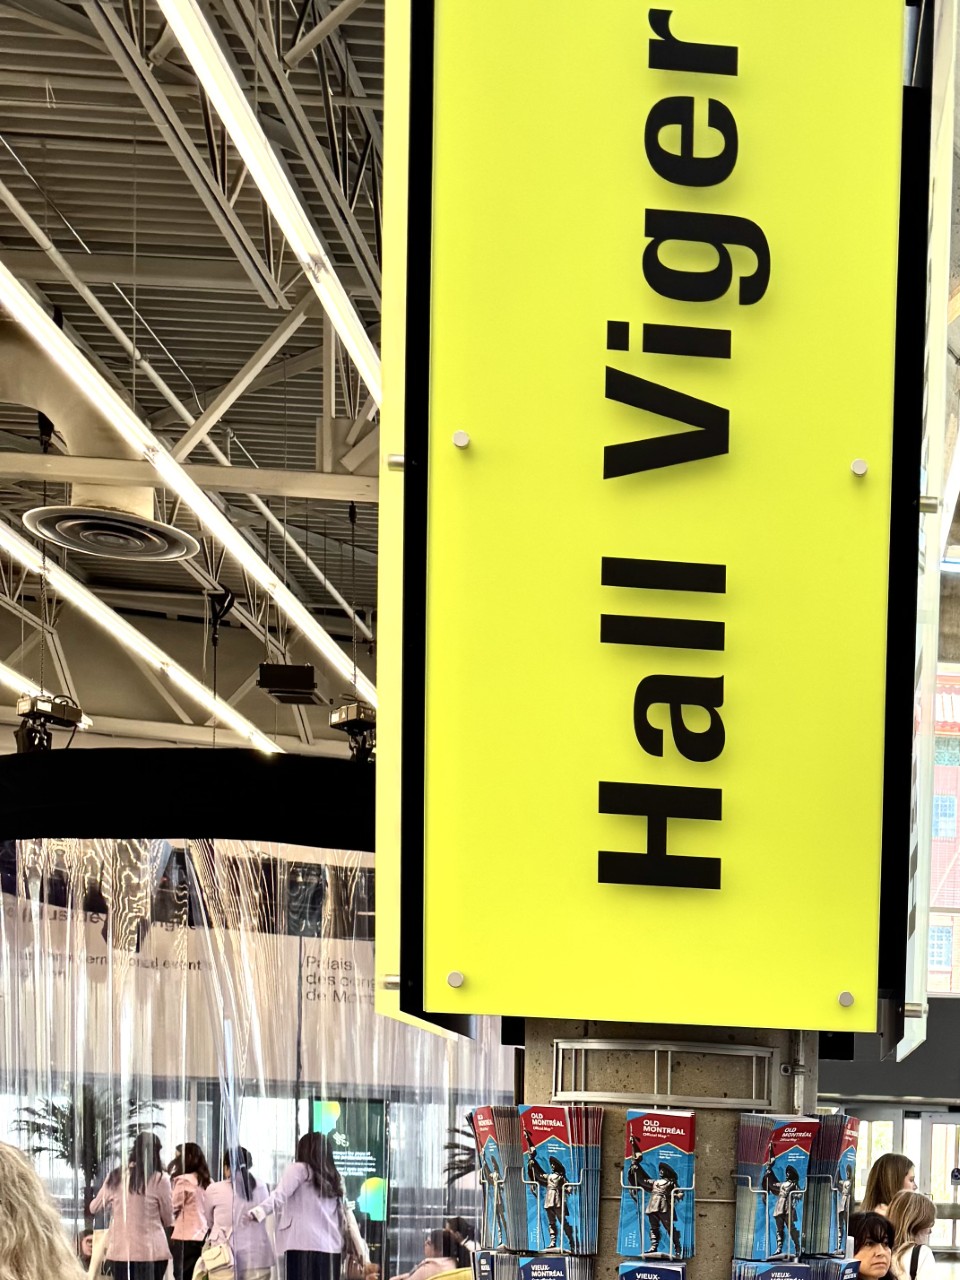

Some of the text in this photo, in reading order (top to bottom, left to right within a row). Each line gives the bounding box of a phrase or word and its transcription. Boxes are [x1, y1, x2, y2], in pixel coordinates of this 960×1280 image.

[598, 8, 771, 890] Hall Viger
[531, 1112, 544, 1120] OLD
[531, 1118, 564, 1128] MONTRÉAL
[643, 1119, 660, 1127] OLD
[643, 1126, 686, 1136] MONTRÉAL
[635, 1272, 660, 1280] VIEUX-
